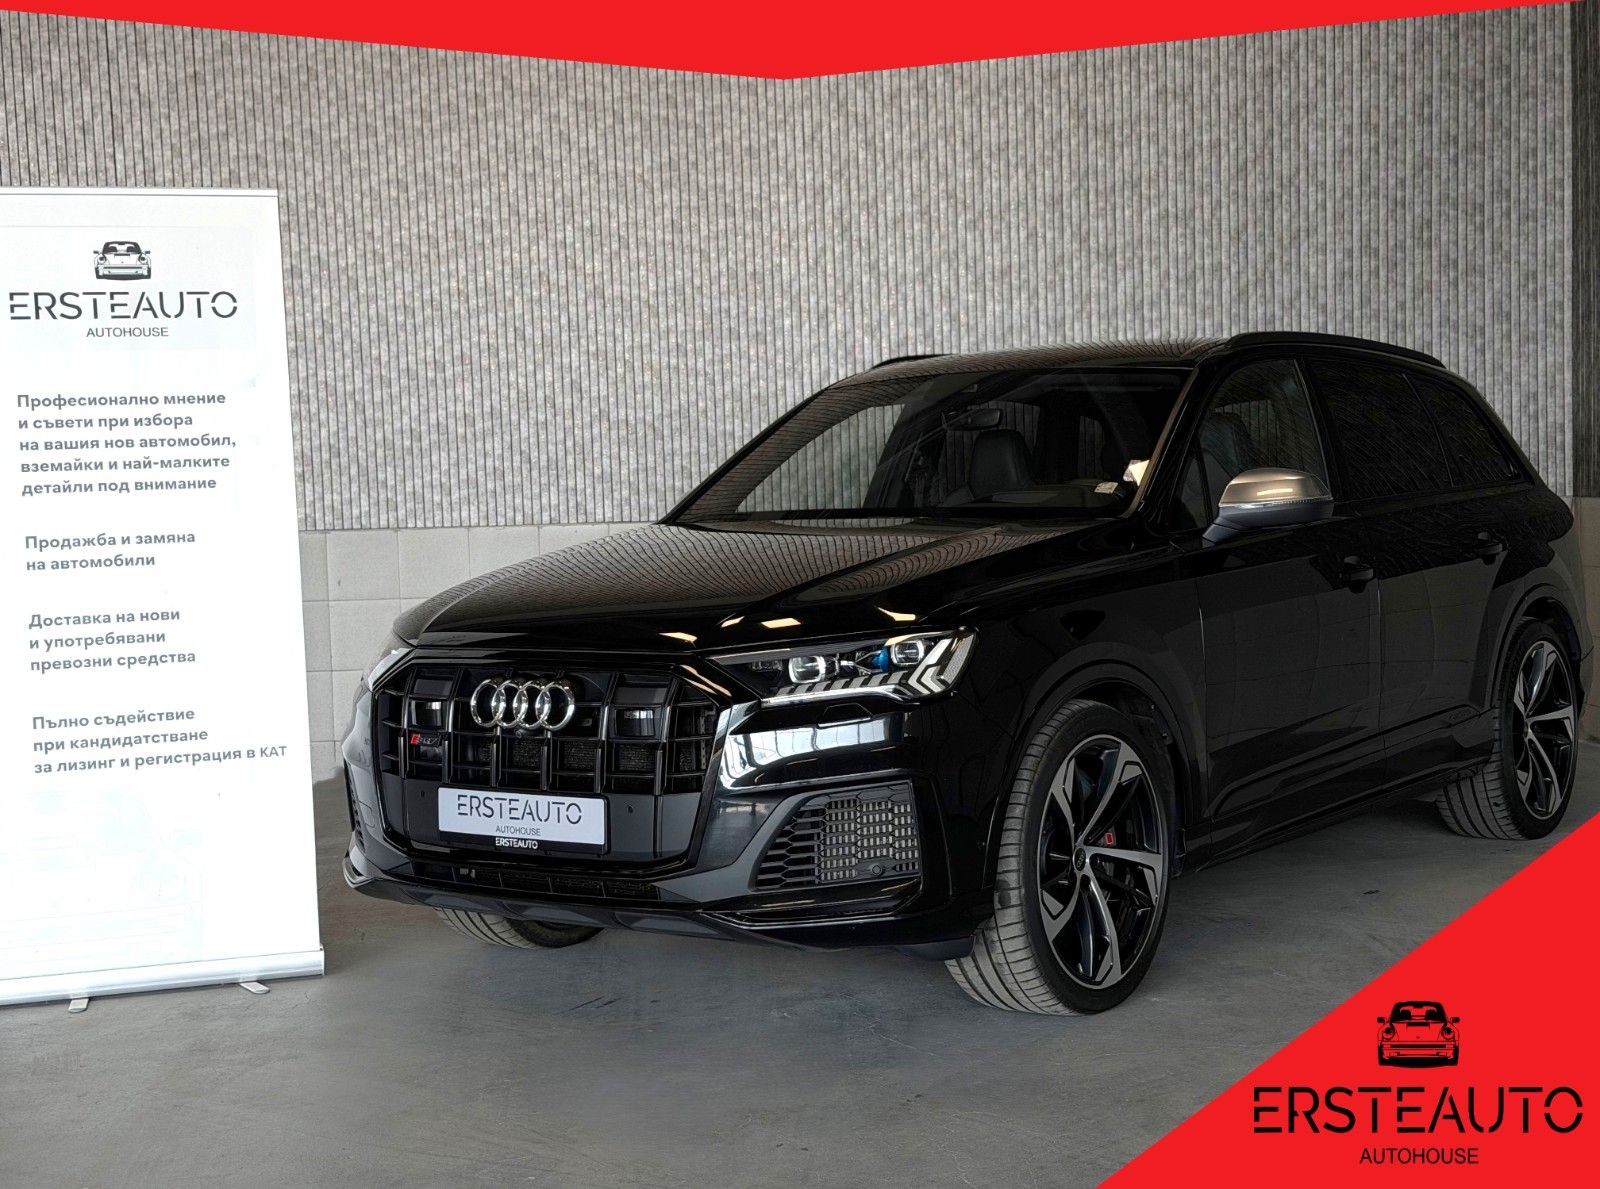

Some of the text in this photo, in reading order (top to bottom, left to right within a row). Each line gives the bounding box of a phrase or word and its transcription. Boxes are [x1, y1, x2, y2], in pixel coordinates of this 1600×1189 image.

[9, 291, 237, 320] ERSTEAUTO
[86, 327, 169, 338] AUTOHOUSE
[17, 393, 226, 411] Професионално мнение
[18, 414, 193, 430] и съвети при избора
[20, 434, 236, 451] на вашия нов автомобил,
[21, 456, 230, 473] вземайки и най-малките
[22, 478, 217, 496] детайли под внимание
[25, 532, 196, 552] Продажба и замяна
[26, 554, 155, 571] на автомобили
[29, 610, 181, 629] Доставка на нови
[29, 631, 166, 652] и употребявани
[31, 651, 196, 674] превозни средства
[32, 709, 195, 730] Пълно съдействие
[33, 729, 208, 754] при кандидатстване
[34, 745, 288, 774] за лизинг и регистрация в КАТ
[457, 794, 582, 825] ERSTEAUTO
[495, 825, 541, 836] AUTOHOUSE
[495, 838, 538, 849] ERSTEAUTO
